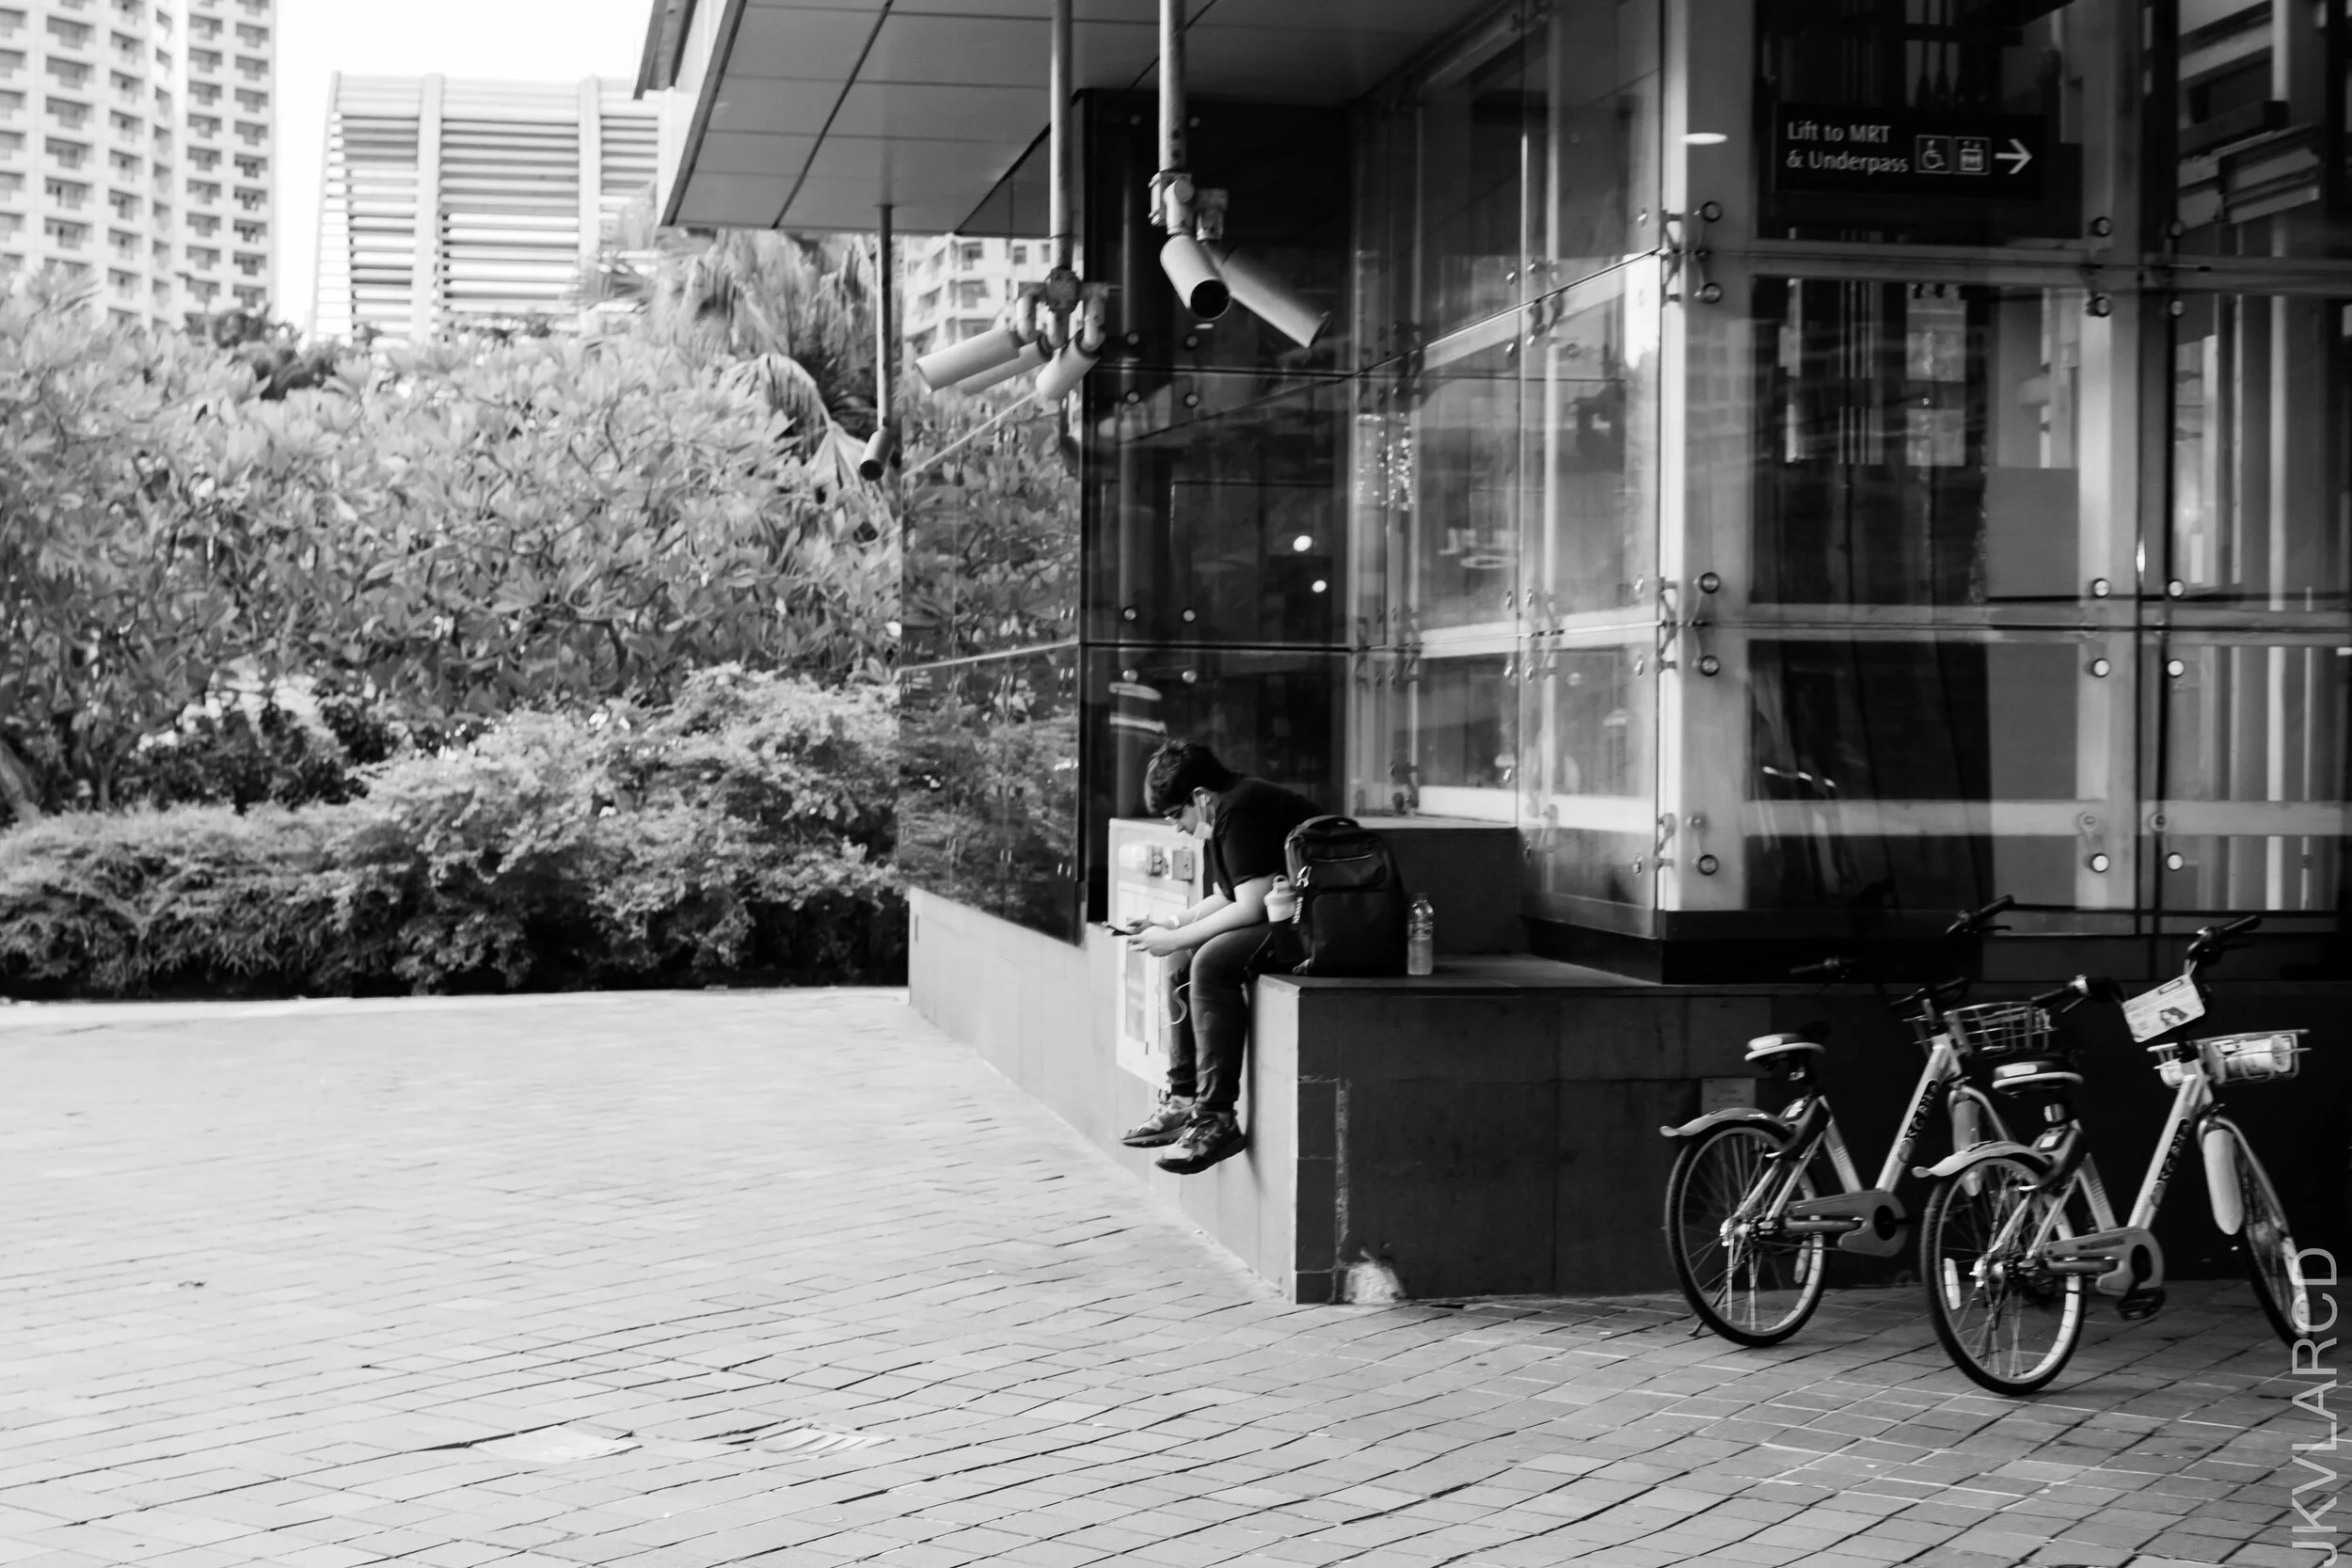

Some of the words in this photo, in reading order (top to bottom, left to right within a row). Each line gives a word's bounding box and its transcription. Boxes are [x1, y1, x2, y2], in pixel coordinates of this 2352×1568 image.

[1787, 120, 1818, 140] Lift
[1823, 124, 1844, 142] to
[1849, 124, 1891, 143] MRT
[1786, 149, 1804, 168] &
[1808, 150, 1909, 175] Underpass
